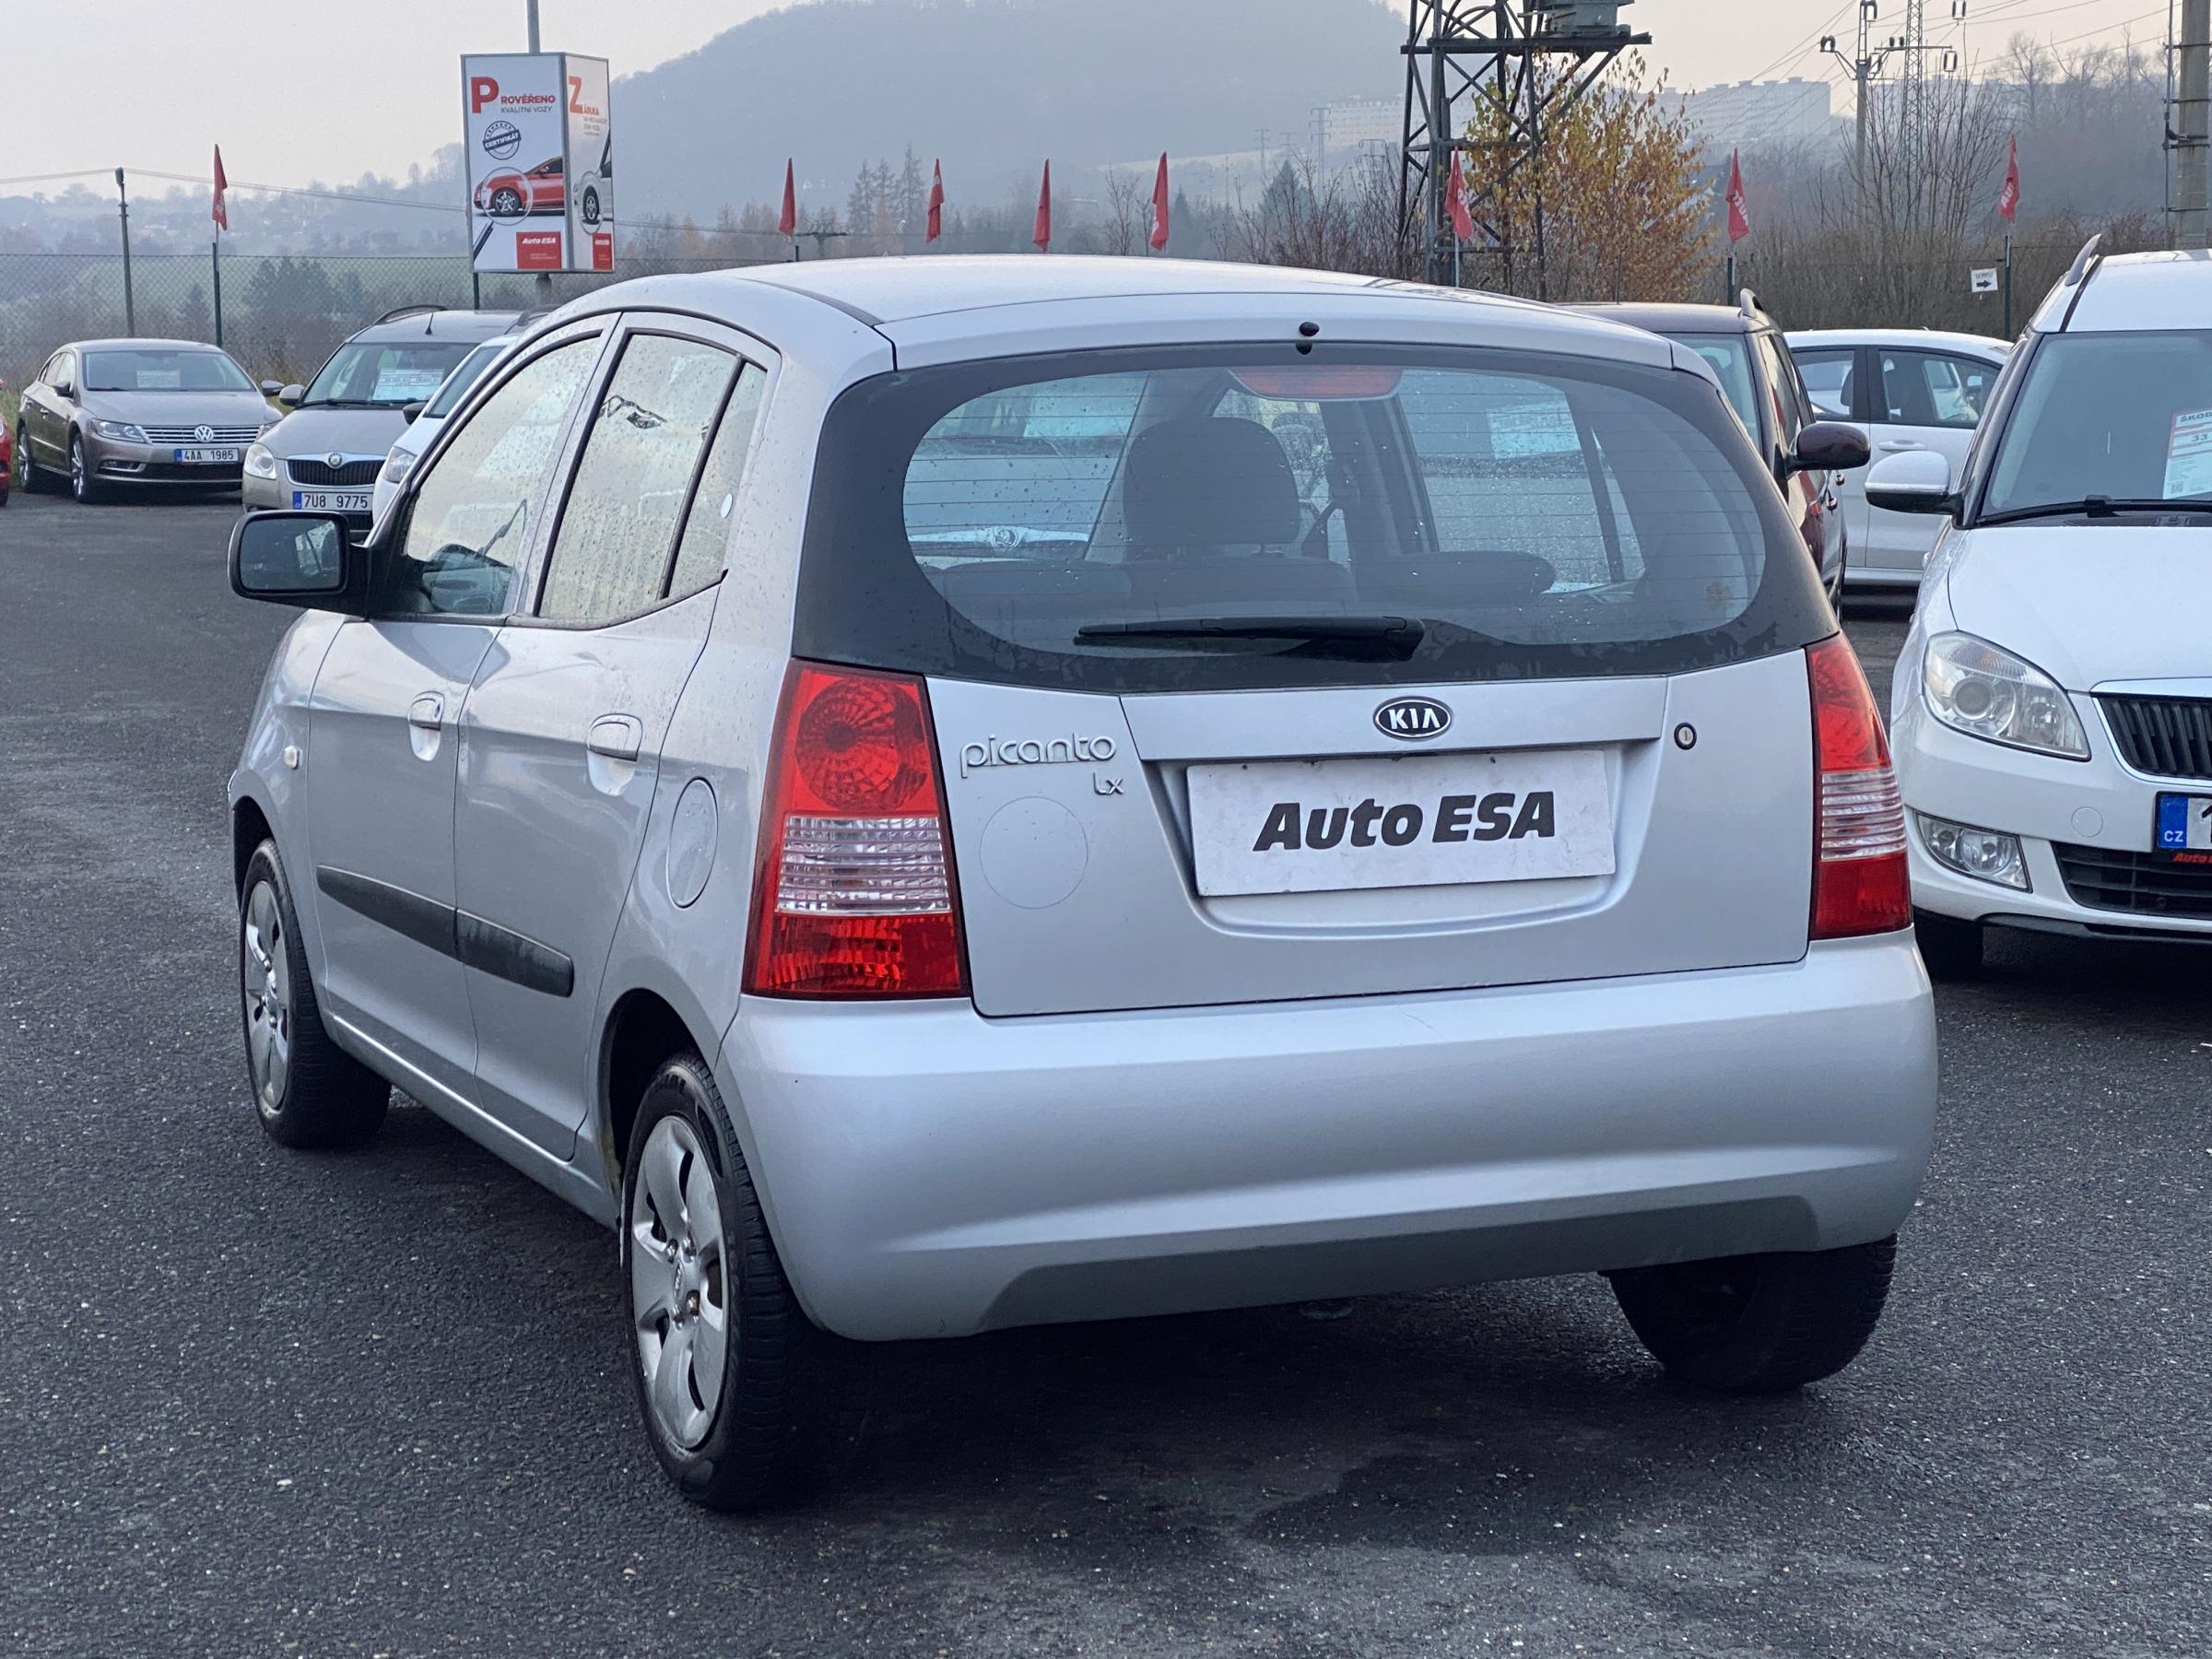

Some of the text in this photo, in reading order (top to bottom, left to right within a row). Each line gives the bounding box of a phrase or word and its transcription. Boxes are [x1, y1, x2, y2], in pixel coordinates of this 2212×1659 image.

[184, 451, 233, 460] 4AA 1985
[304, 495, 325, 508] 7U8
[336, 496, 368, 508] 9775
[1388, 708, 1440, 729] KIA
[960, 732, 1116, 779] picanto
[1253, 792, 1555, 852] Auto ESA
[2164, 830, 2183, 842] CZ
